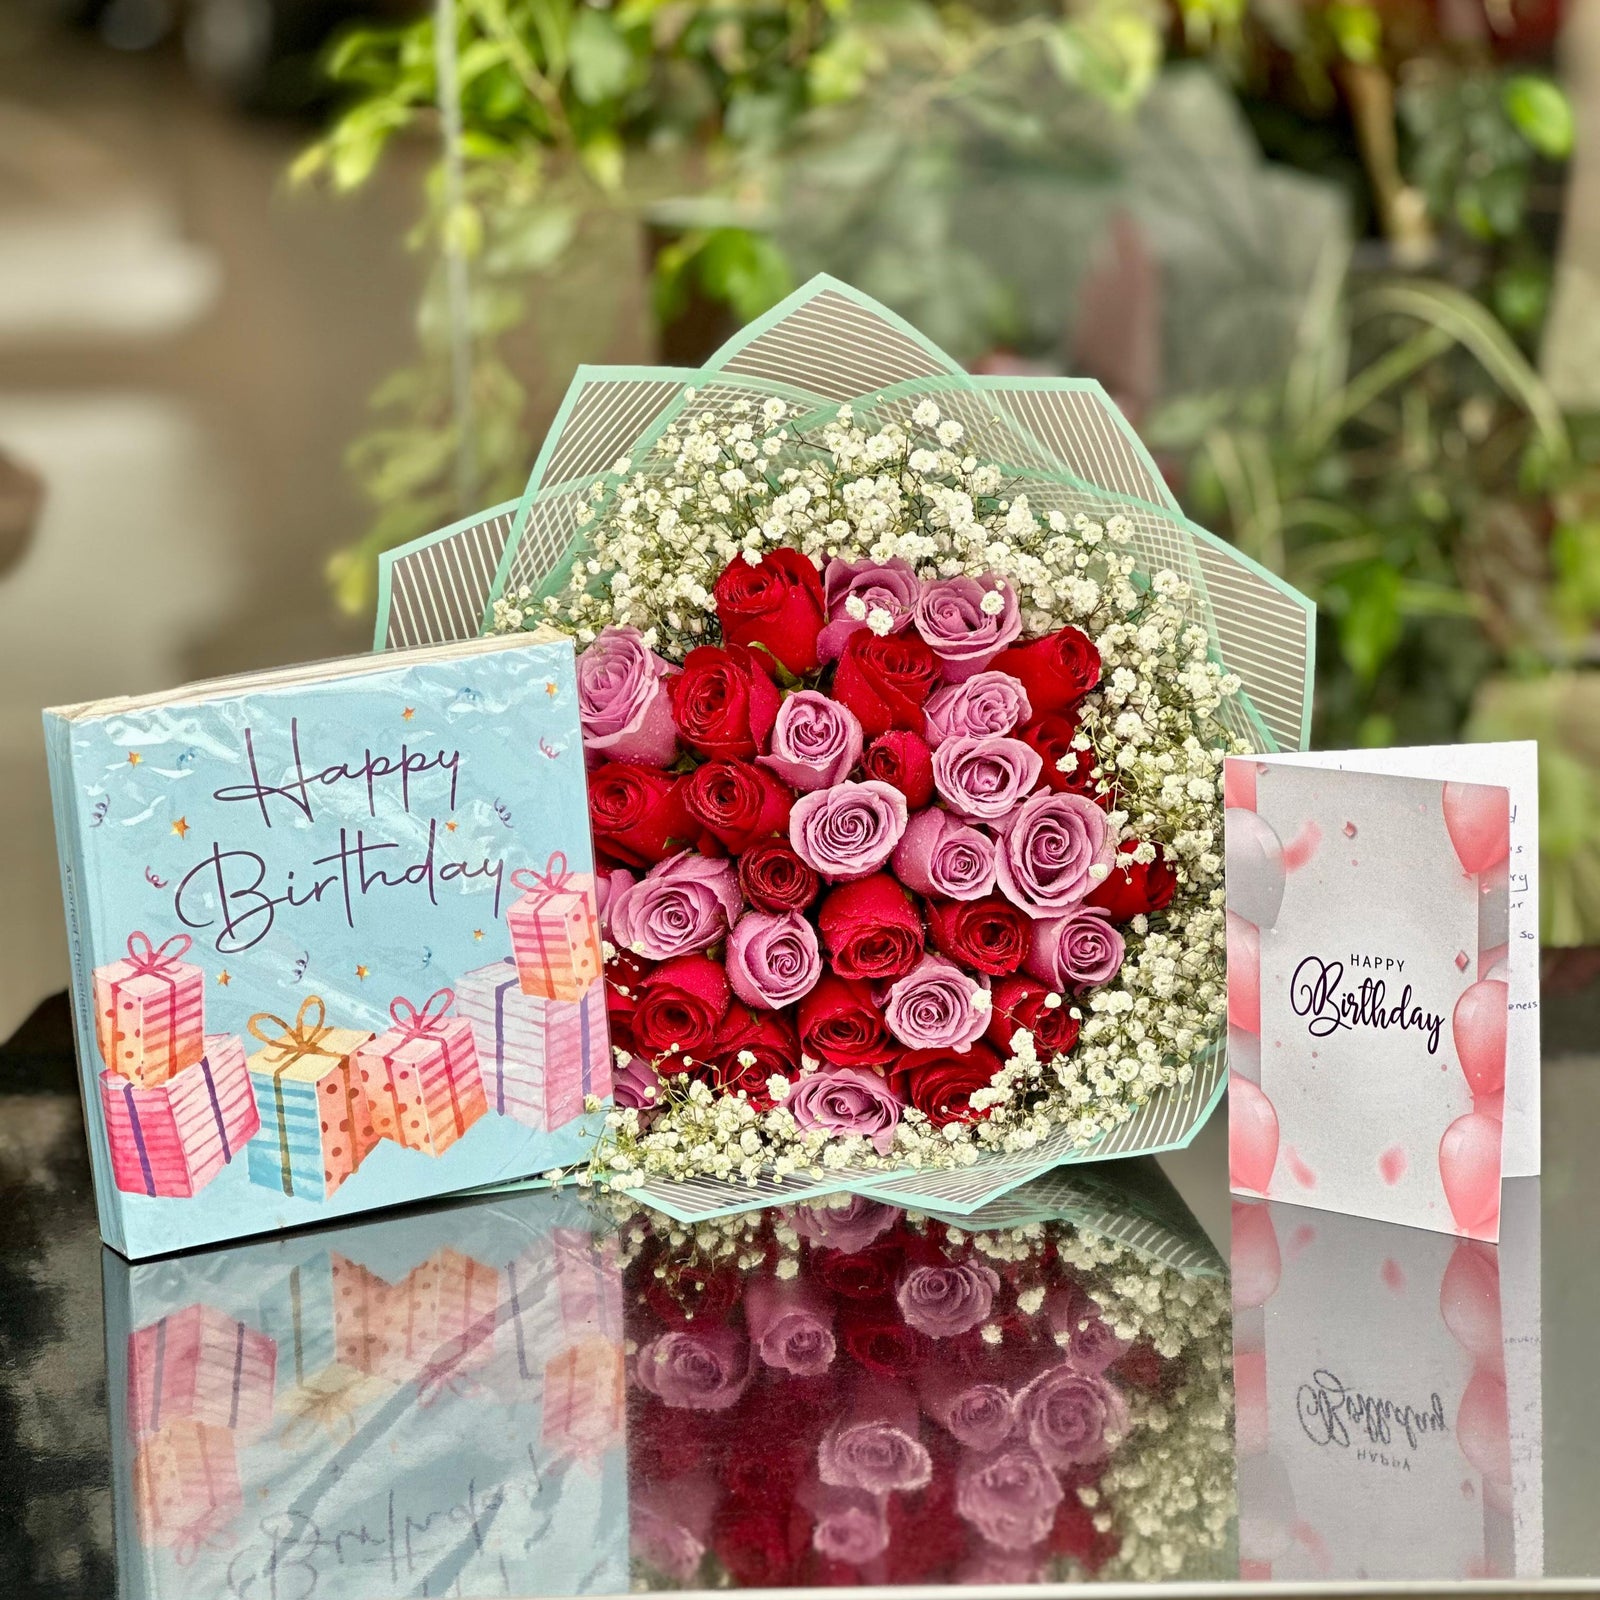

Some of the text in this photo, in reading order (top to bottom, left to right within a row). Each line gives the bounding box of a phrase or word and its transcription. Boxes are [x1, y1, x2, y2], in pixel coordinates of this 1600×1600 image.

[213, 717, 461, 828] Happy
[65, 863, 80, 935] Assorted
[174, 819, 505, 954] Birthday
[1290, 956, 1446, 1055] Birthday
[1350, 953, 1405, 973] HAPPY
